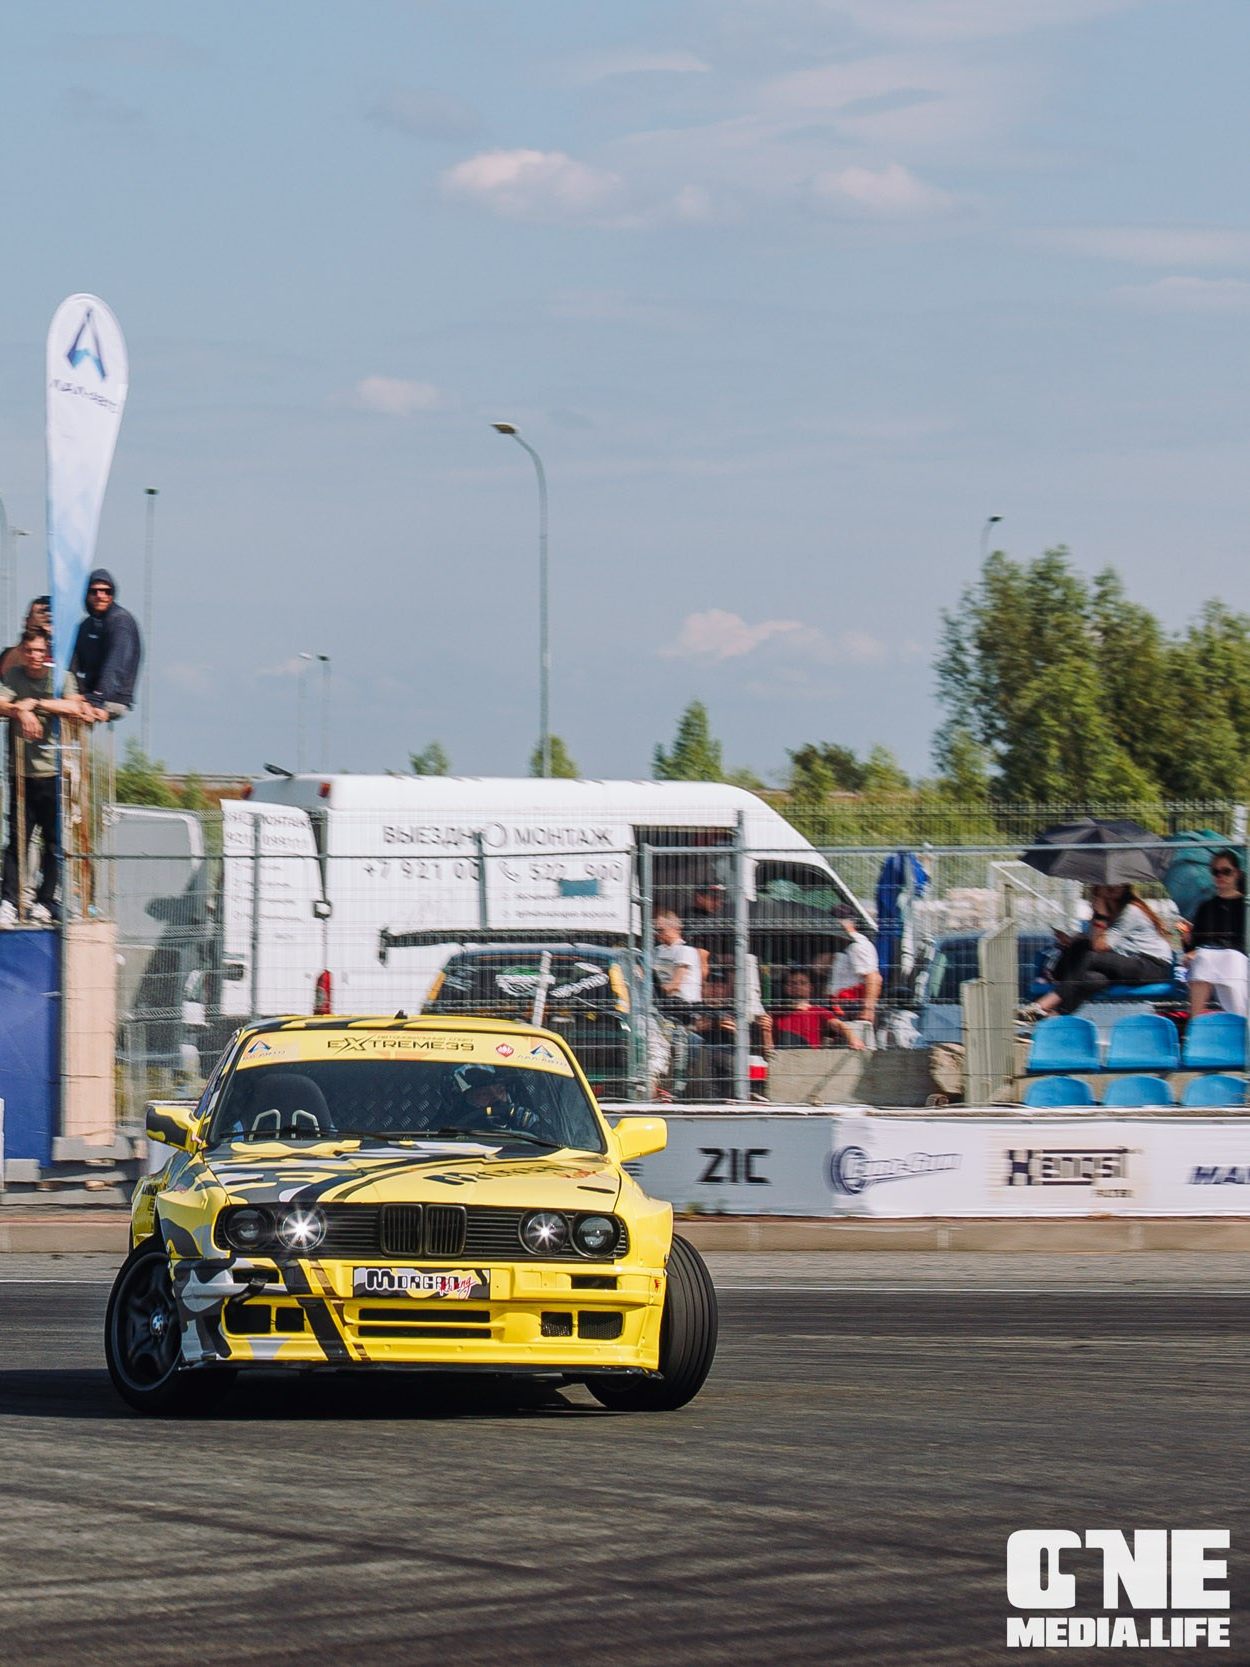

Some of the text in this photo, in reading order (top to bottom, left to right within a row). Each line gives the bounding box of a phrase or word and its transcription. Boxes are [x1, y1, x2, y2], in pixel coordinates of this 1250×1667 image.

[514, 826, 613, 847] МОНТАЖ
[400, 861, 442, 880] 921
[327, 1034, 474, 1054] EXTREME39
[696, 1148, 772, 1184] ZIC
